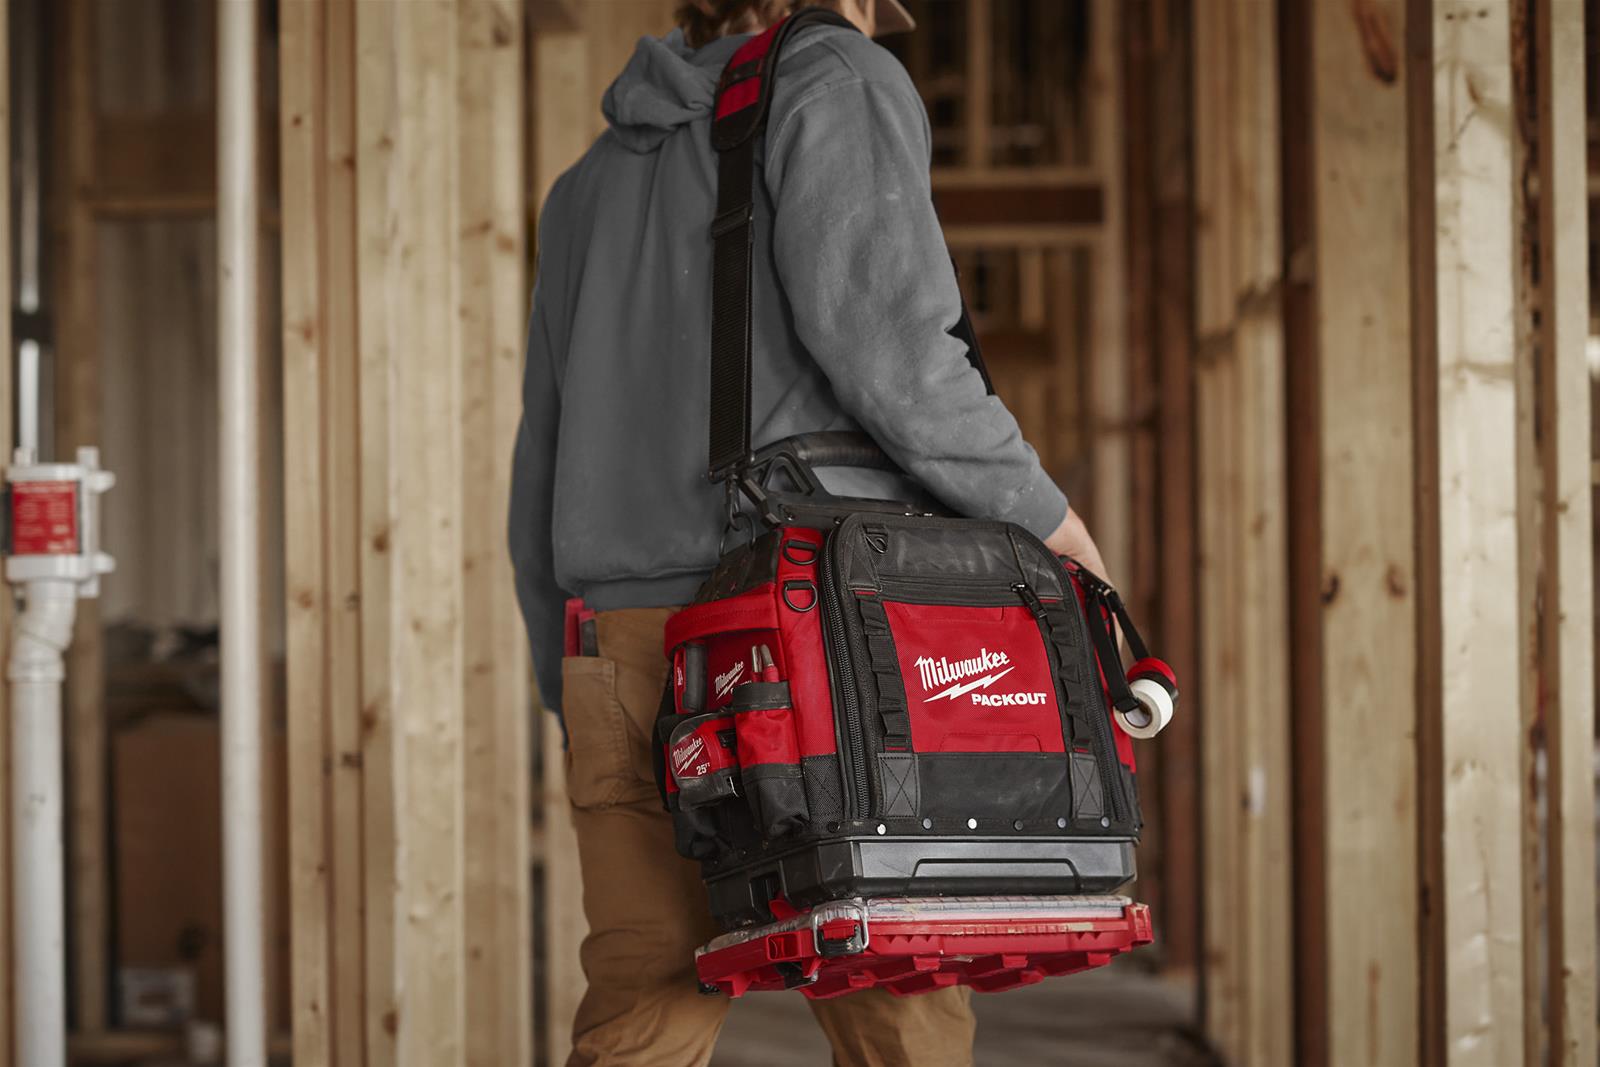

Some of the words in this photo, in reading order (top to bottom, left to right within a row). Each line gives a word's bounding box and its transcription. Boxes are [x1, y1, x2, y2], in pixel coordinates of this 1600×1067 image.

[914, 647, 1010, 691] Milwaukee
[971, 692, 1047, 707] PACKOUT
[673, 737, 703, 769] Milwaukee
